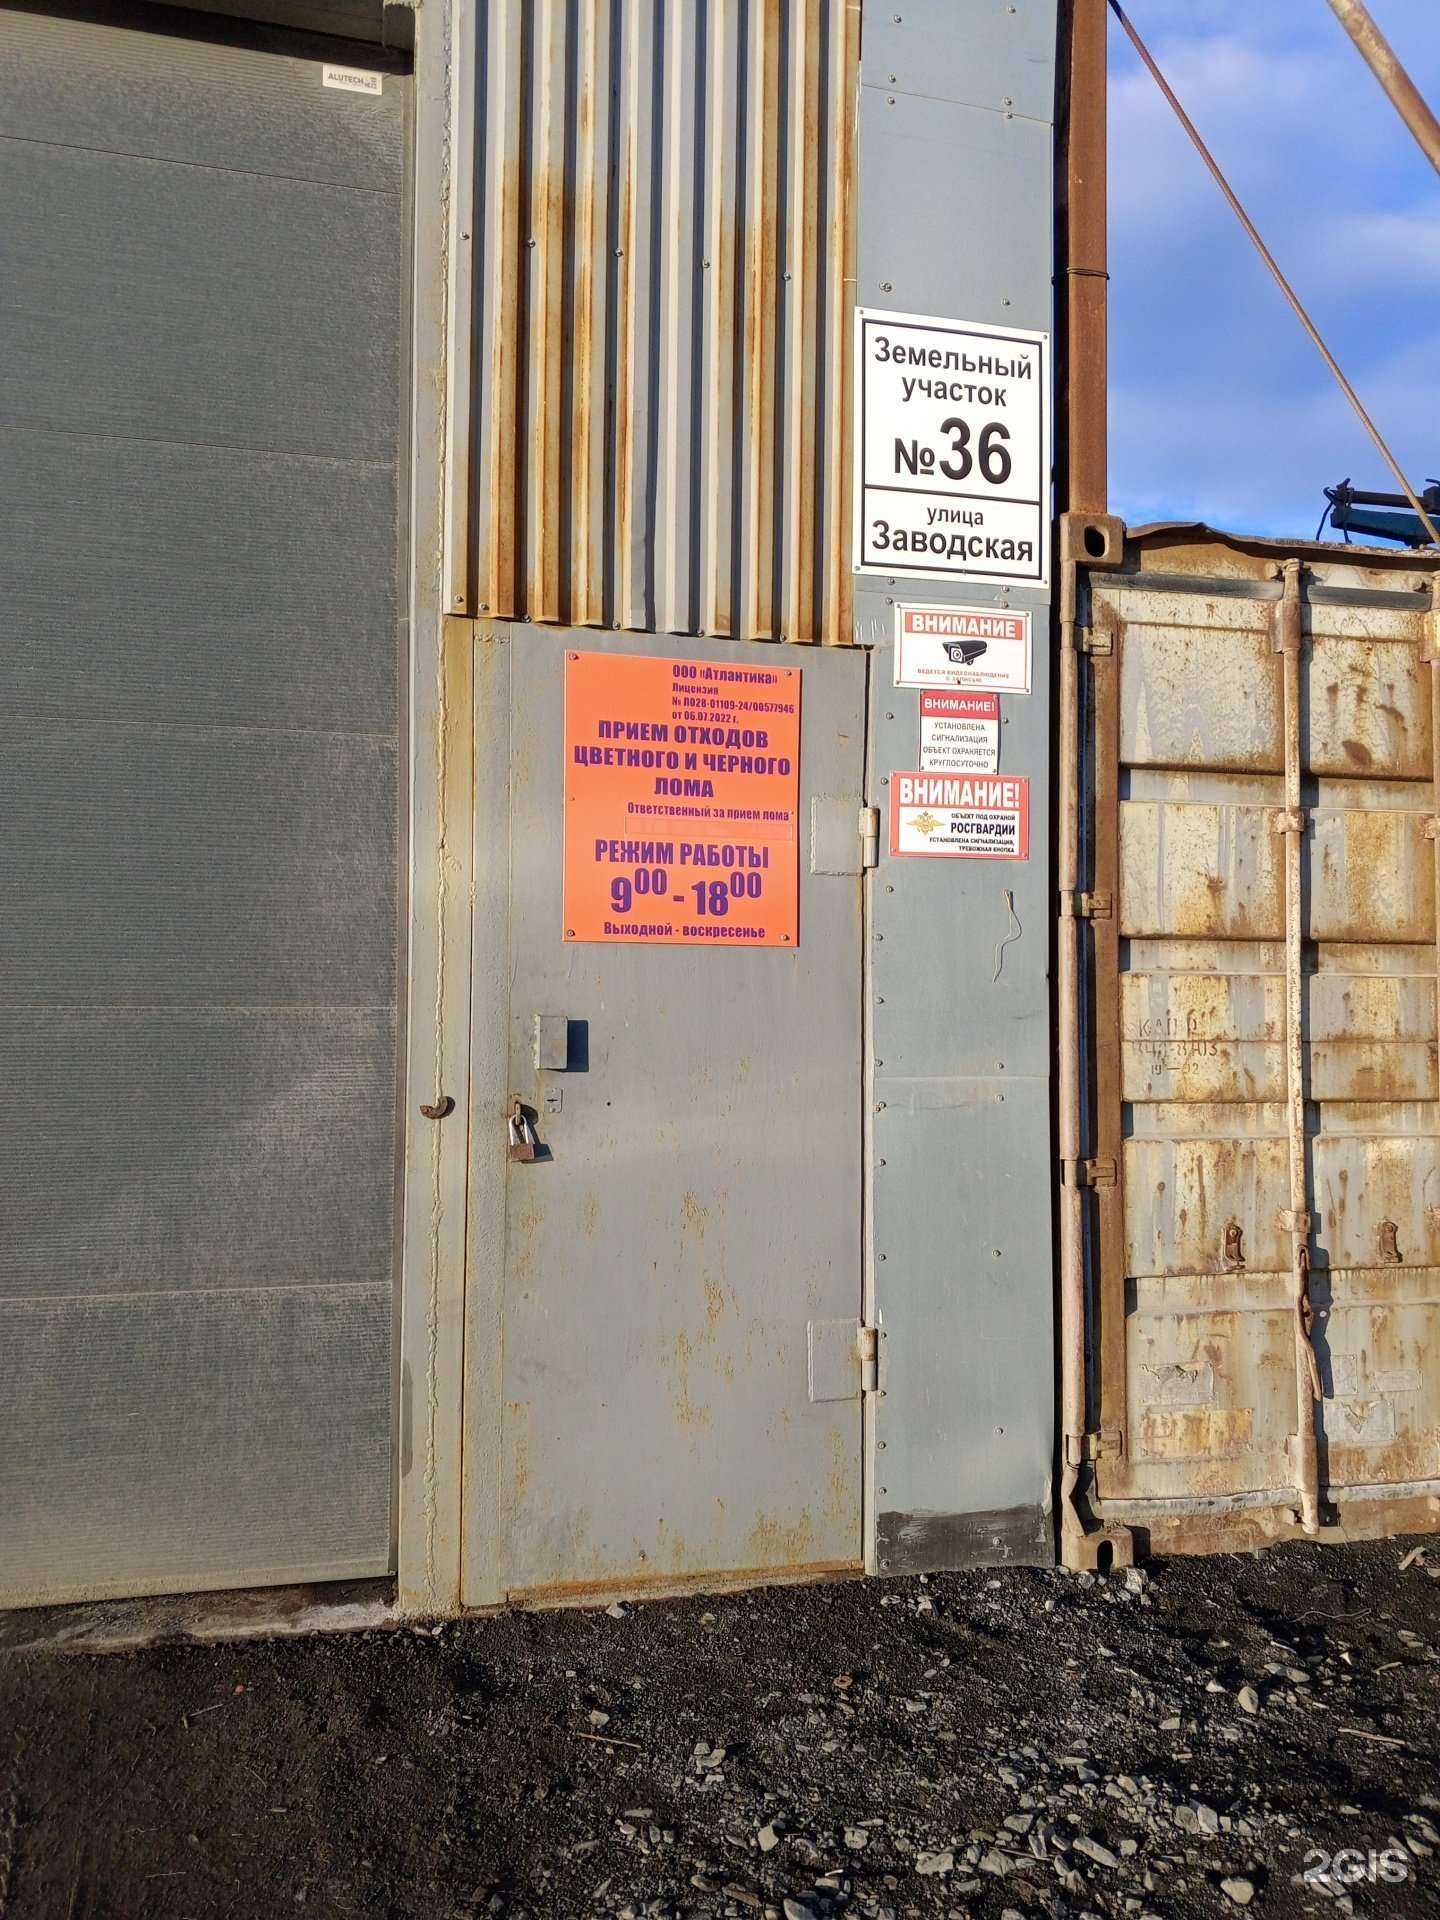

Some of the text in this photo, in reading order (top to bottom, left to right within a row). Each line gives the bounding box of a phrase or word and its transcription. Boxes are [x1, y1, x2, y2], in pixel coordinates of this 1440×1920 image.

[328, 72, 364, 84] ALUTECH
[874, 336, 1032, 379] Земельный
[902, 376, 1007, 407] участок
[927, 507, 984, 527] улица
[871, 519, 1033, 562] Заводская
[912, 614, 1016, 638] ВНИМАНИЕ
[672, 664, 778, 685] ООО «Атлантика»
[672, 682, 719, 696] Лицензия
[672, 696, 681, 706] №
[924, 698, 995, 712] ВНИМАНИЕ!
[672, 711, 682, 720] от
[684, 711, 731, 723] 06.07.2022
[934, 722, 985, 731] УСТАНОВЛЕНА
[599, 720, 769, 750] ПРИЕМ ОТХОДОВ
[931, 734, 988, 744] СИГНАЛИЗАЦИЯ
[574, 746, 790, 776] ЦВЕТНОГО И ЧЕРНОГО
[923, 746, 996, 757] ОБЪЕКТ ОХРАНЯЕТСЯ
[929, 759, 989, 768] КРУГЛОСУТОЧНО
[654, 777, 714, 798] ЛОМА
[900, 778, 1020, 808] ВНИМАНИЕ!
[627, 802, 789, 821] Ответственный за прием лома
[951, 822, 1015, 837] РОСГВАРДИИ
[595, 839, 769, 869] РЕЖИМ РАБОТЫ
[604, 921, 672, 937] Выходной
[682, 924, 765, 939] воскресенье
